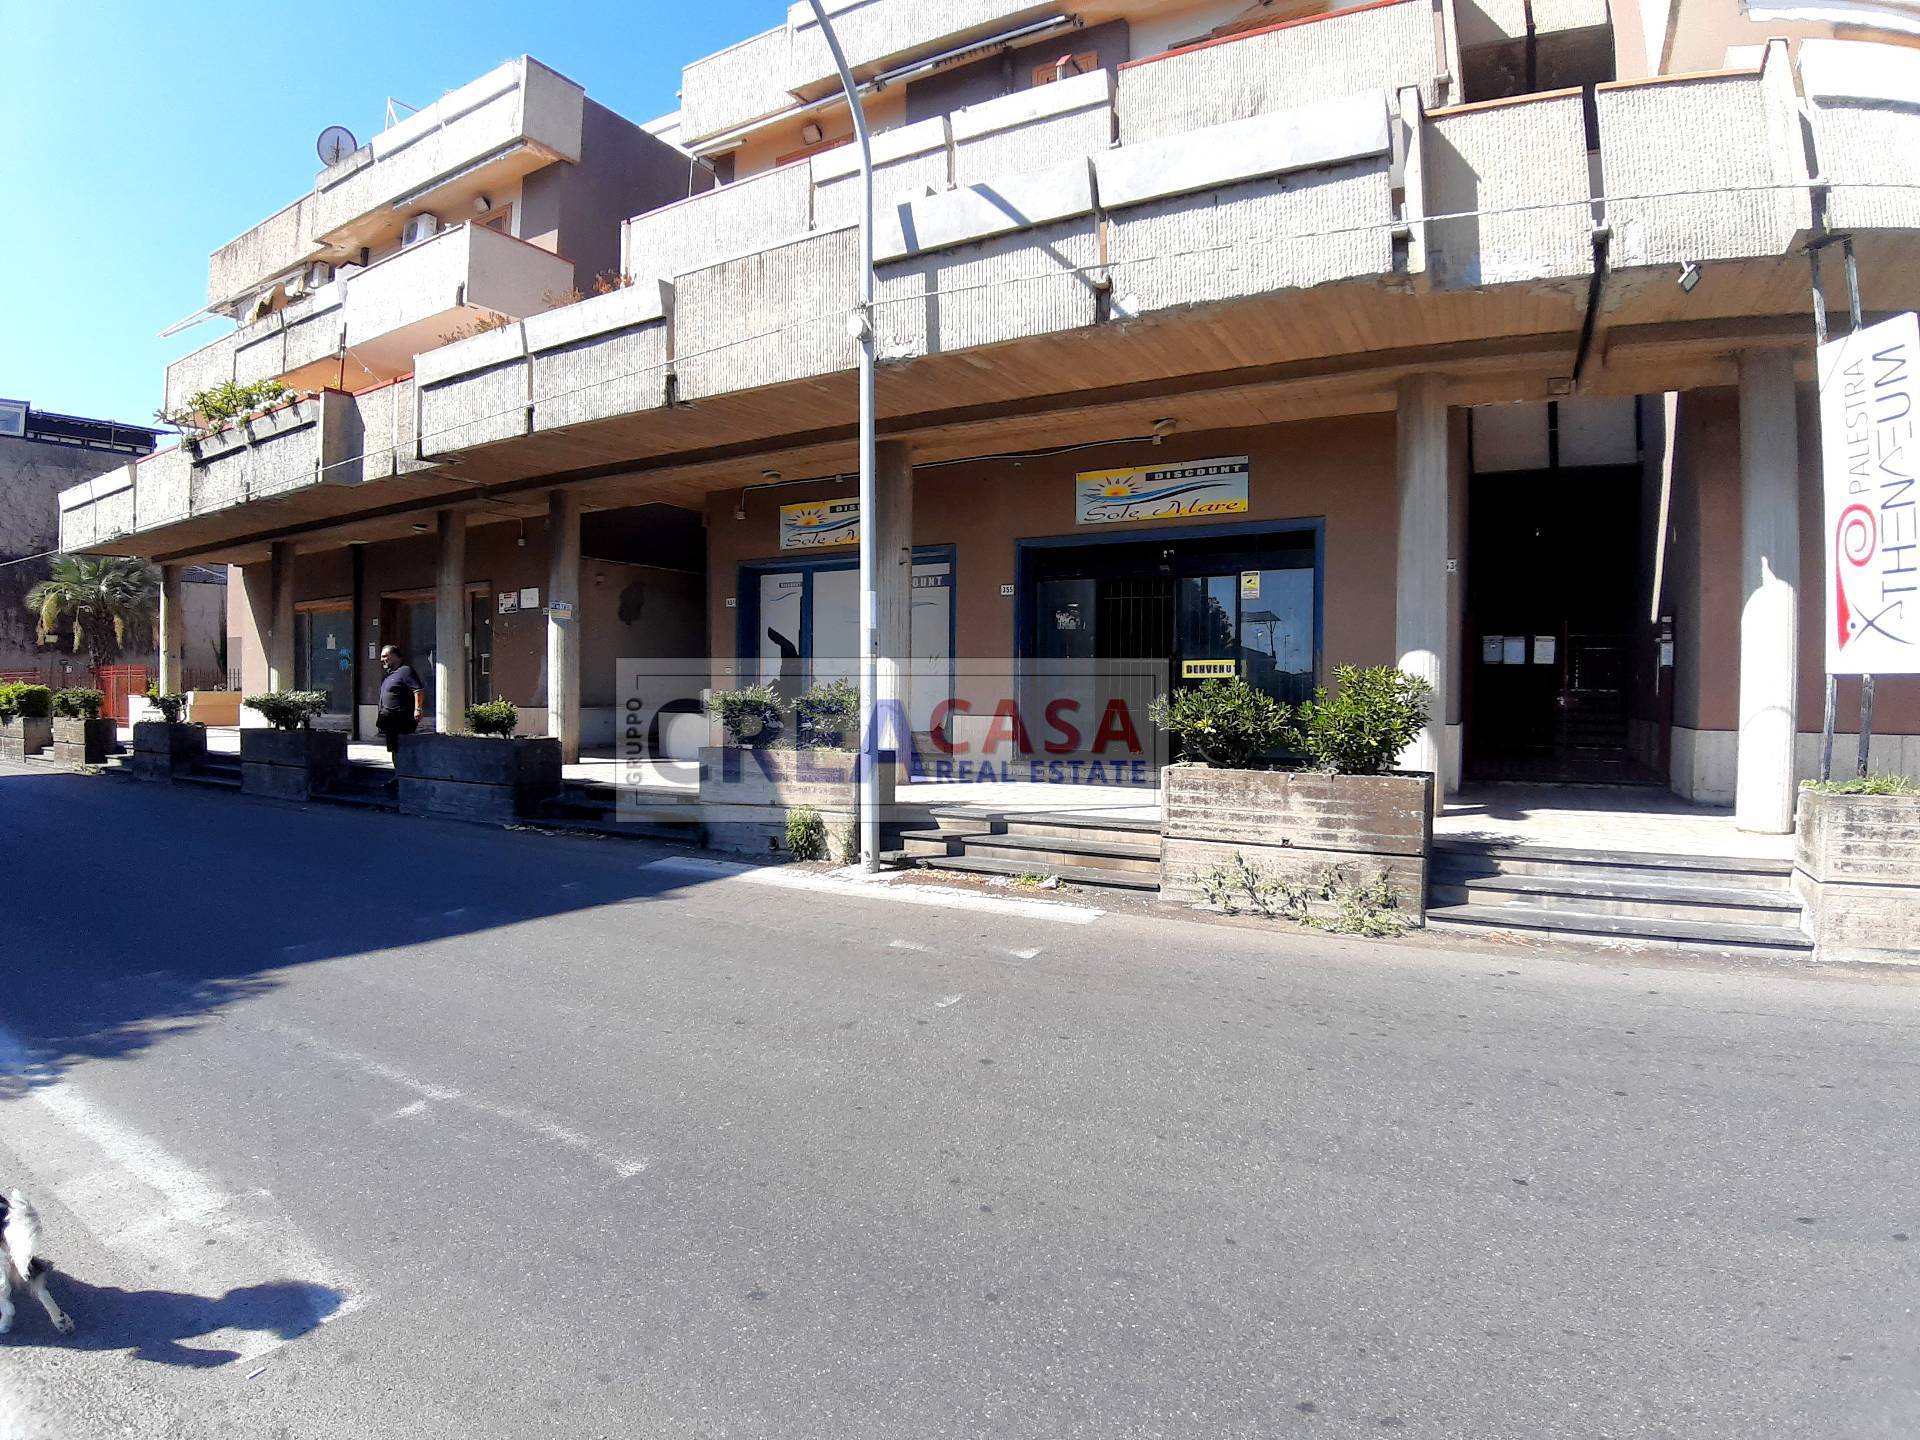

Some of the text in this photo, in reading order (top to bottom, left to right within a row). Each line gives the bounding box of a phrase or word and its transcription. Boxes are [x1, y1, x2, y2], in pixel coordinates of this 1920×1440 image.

[1843, 358, 1871, 496] PALESTRA
[1154, 464, 1243, 480] DISCOUNT
[1083, 498, 1239, 522] Sole Mare
[785, 530, 826, 547] Sole
[912, 576, 943, 587] OUNT
[1186, 664, 1234, 674] BENVENU
